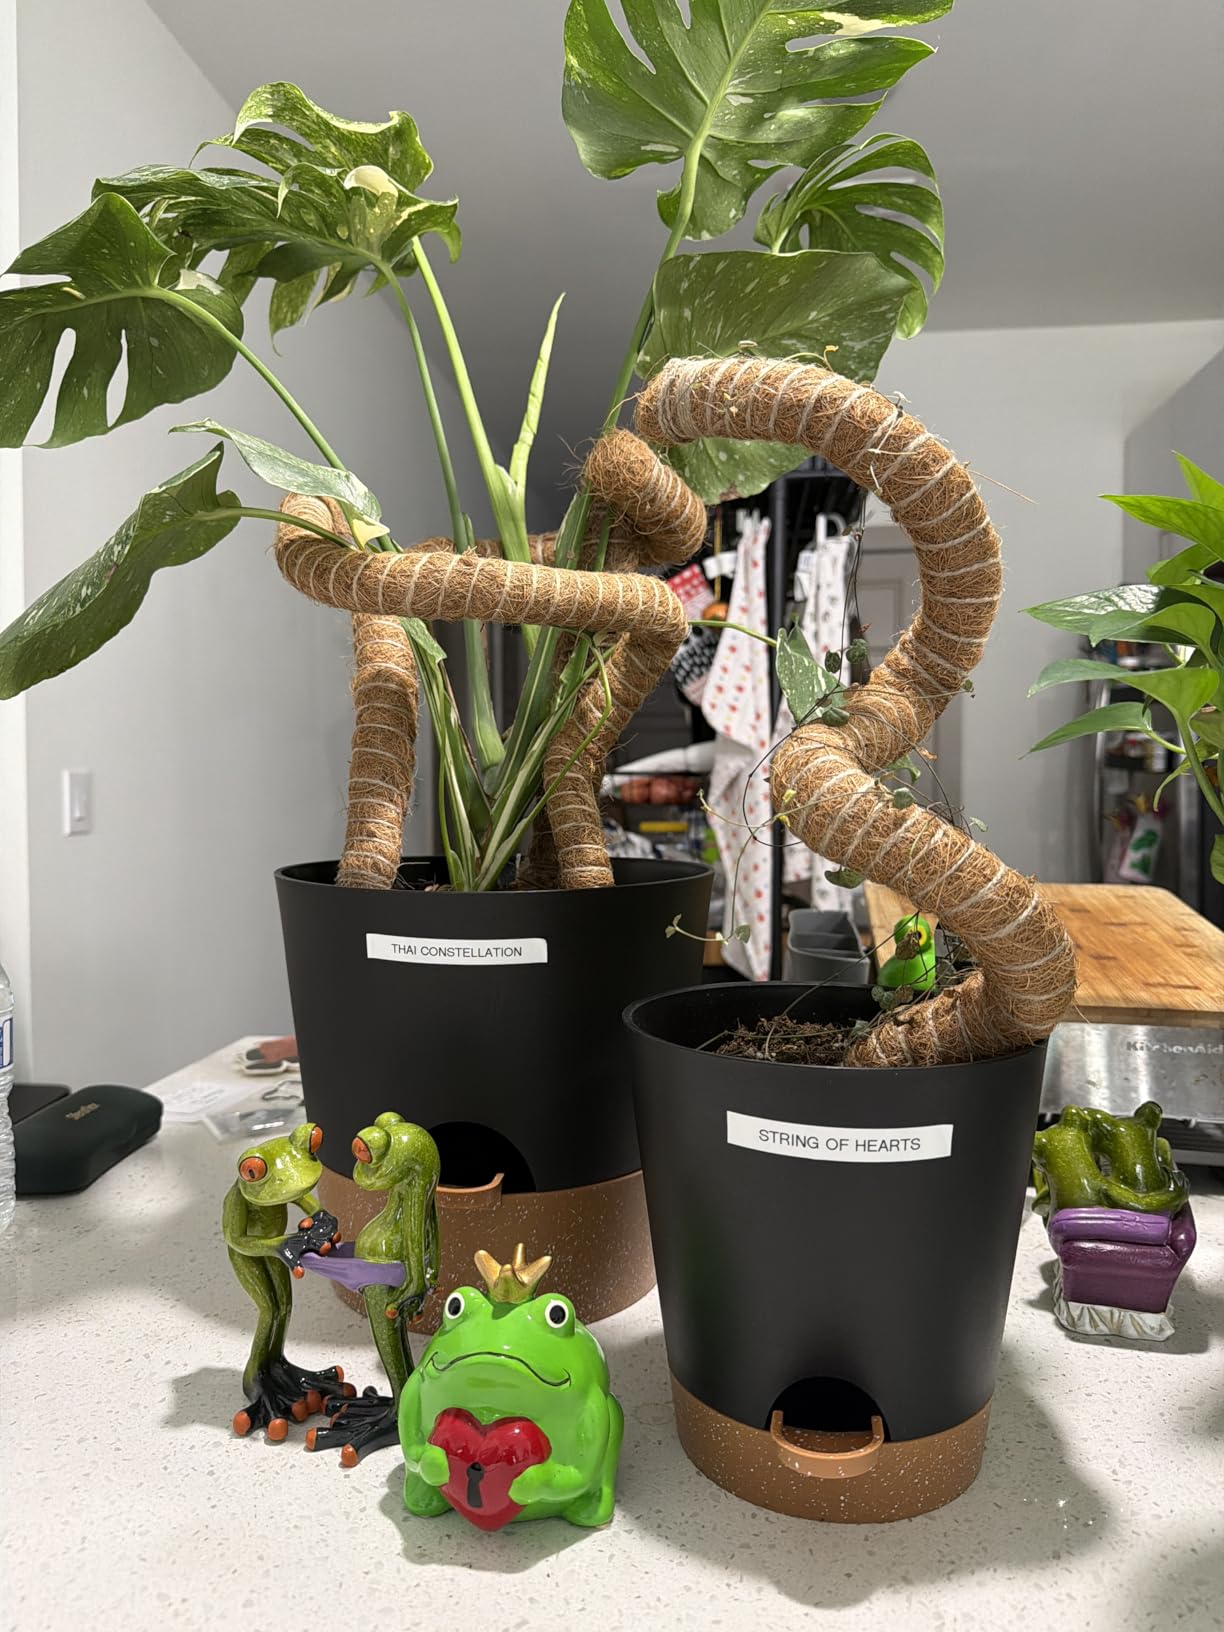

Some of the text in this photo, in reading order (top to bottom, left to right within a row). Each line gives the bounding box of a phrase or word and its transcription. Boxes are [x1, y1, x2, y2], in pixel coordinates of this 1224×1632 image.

[391, 943, 522, 958] THAI CONSTELLATION
[758, 1129, 921, 1152] STRING OF HEARTS
